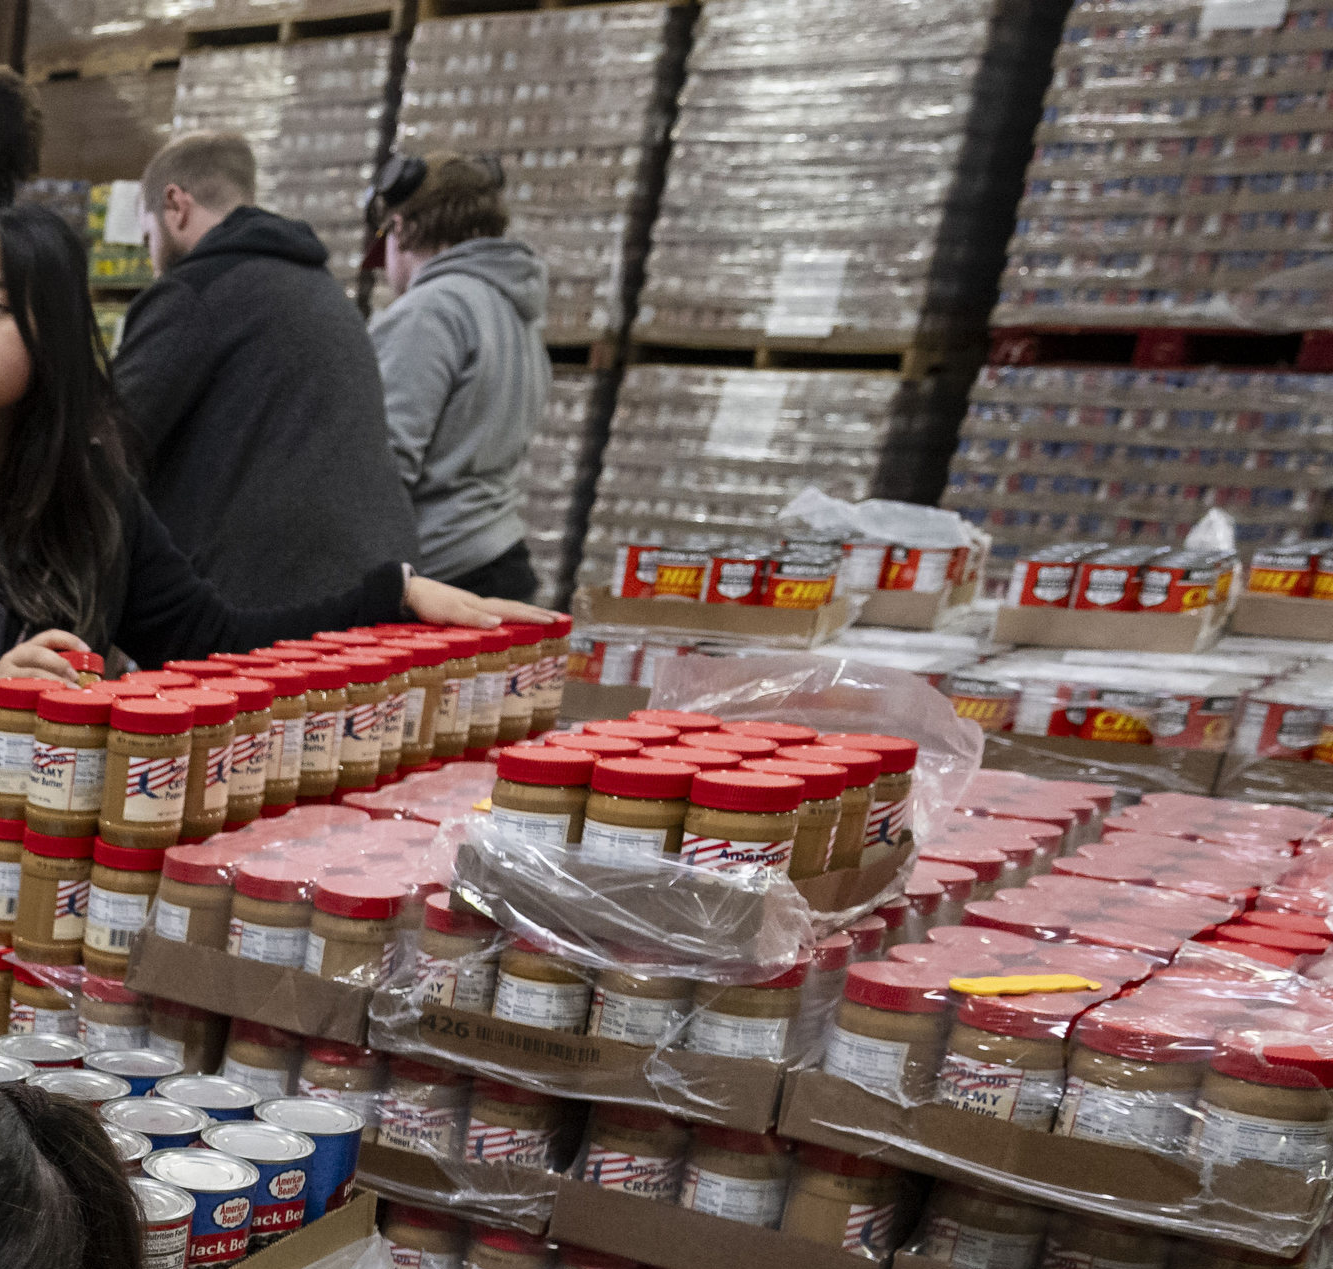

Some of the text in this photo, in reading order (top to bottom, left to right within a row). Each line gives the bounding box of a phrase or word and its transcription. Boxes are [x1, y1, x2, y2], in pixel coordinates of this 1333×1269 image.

[718, 848, 783, 863] American
[275, 1173, 304, 1188] American
[276, 1183, 301, 1198] Beauty
[219, 1202, 249, 1216] American
[221, 1211, 246, 1225] Beauty
